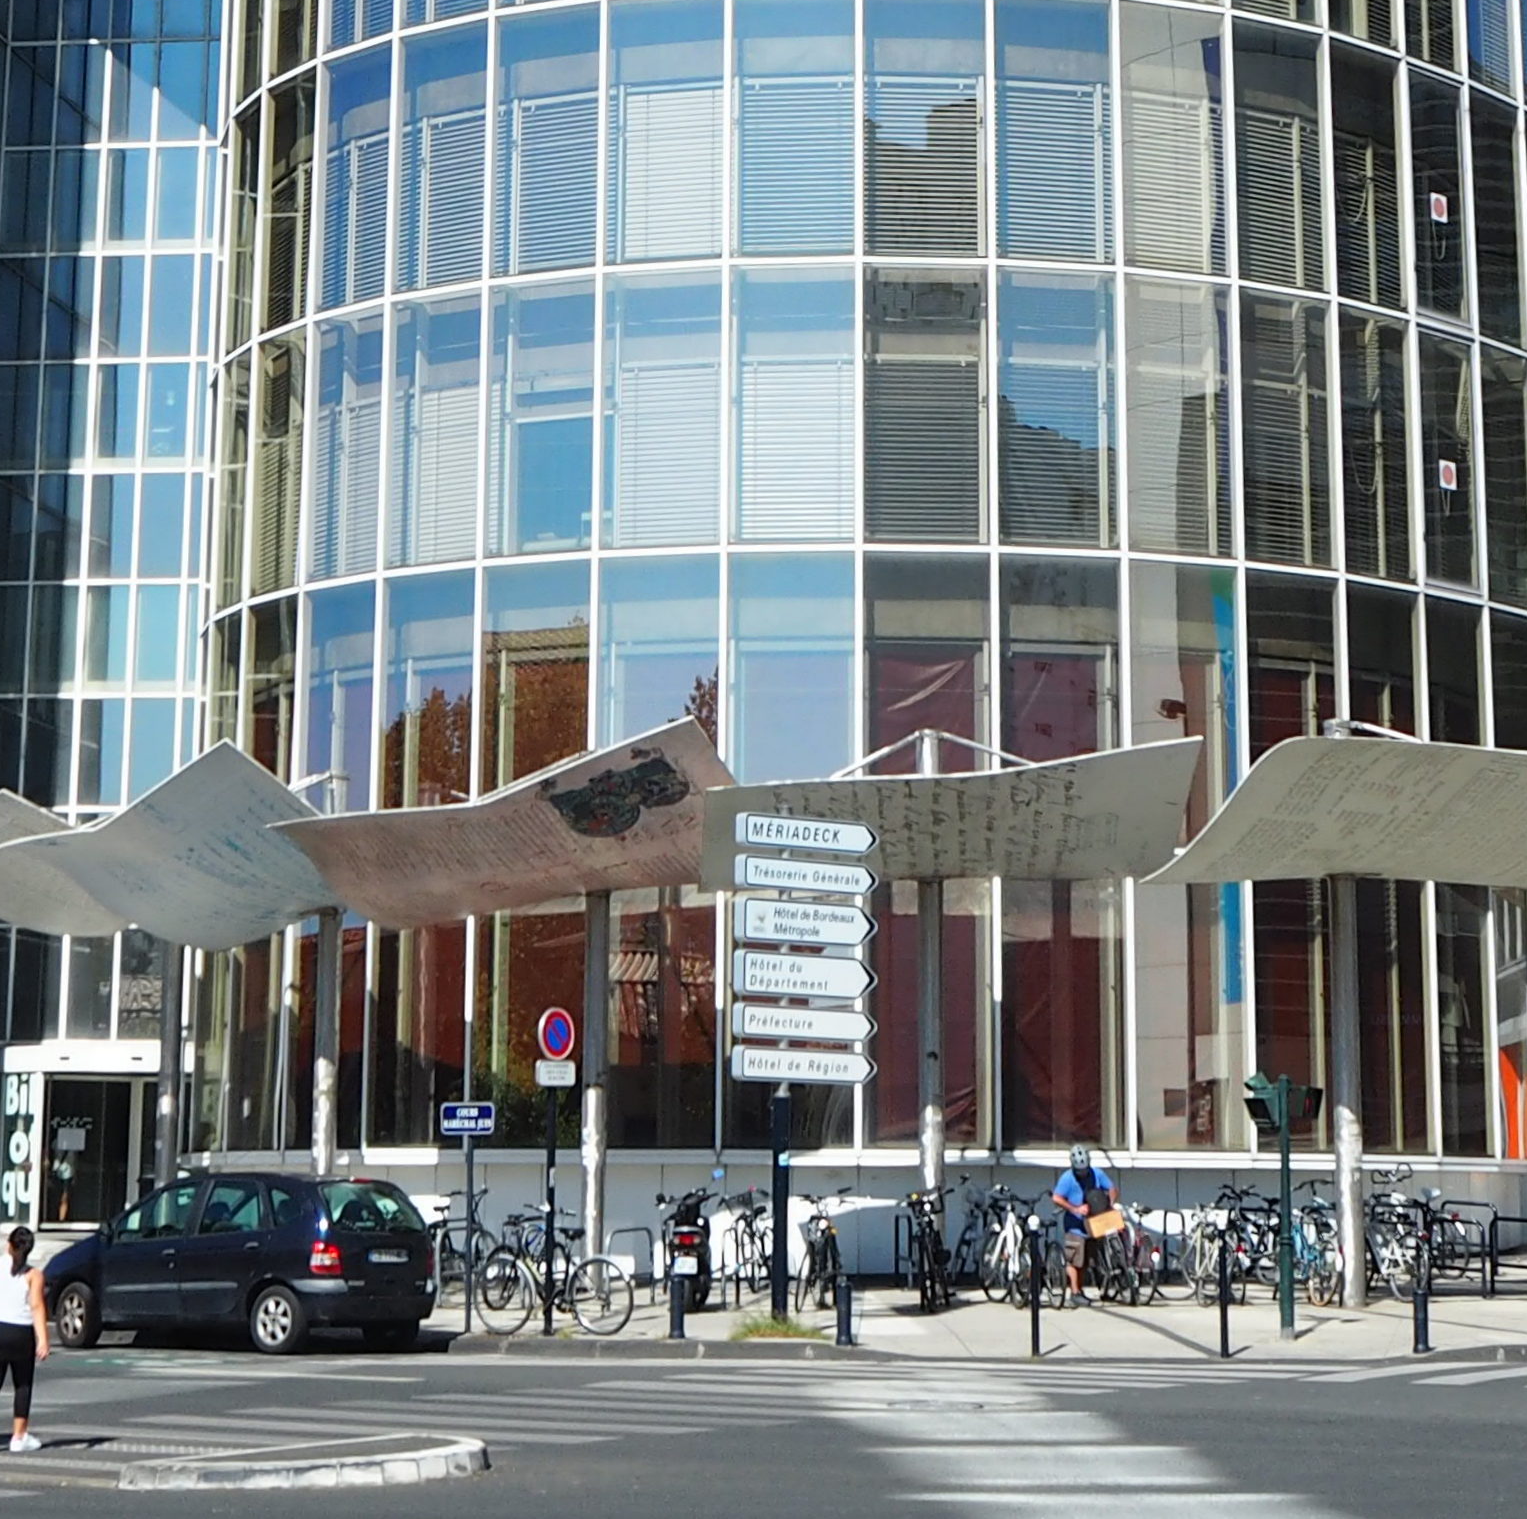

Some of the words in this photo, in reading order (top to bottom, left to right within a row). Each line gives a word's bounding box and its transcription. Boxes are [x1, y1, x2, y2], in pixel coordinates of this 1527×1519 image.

[752, 820, 840, 843] MÉRIADECK
[753, 865, 808, 882] Trésorerie
[812, 870, 861, 887] Générale
[773, 906, 798, 922] Hôtel
[800, 909, 811, 922] de
[813, 909, 855, 924] Bordeaux
[773, 922, 821, 939] Métropole
[750, 957, 783, 971] Hôtel
[789, 961, 803, 974] du
[750, 974, 829, 992] Département
[749, 1013, 814, 1030] Préfecture
[748, 1056, 781, 1072] Hôtel
[787, 1059, 801, 1073] de
[808, 1059, 849, 1077] Région
